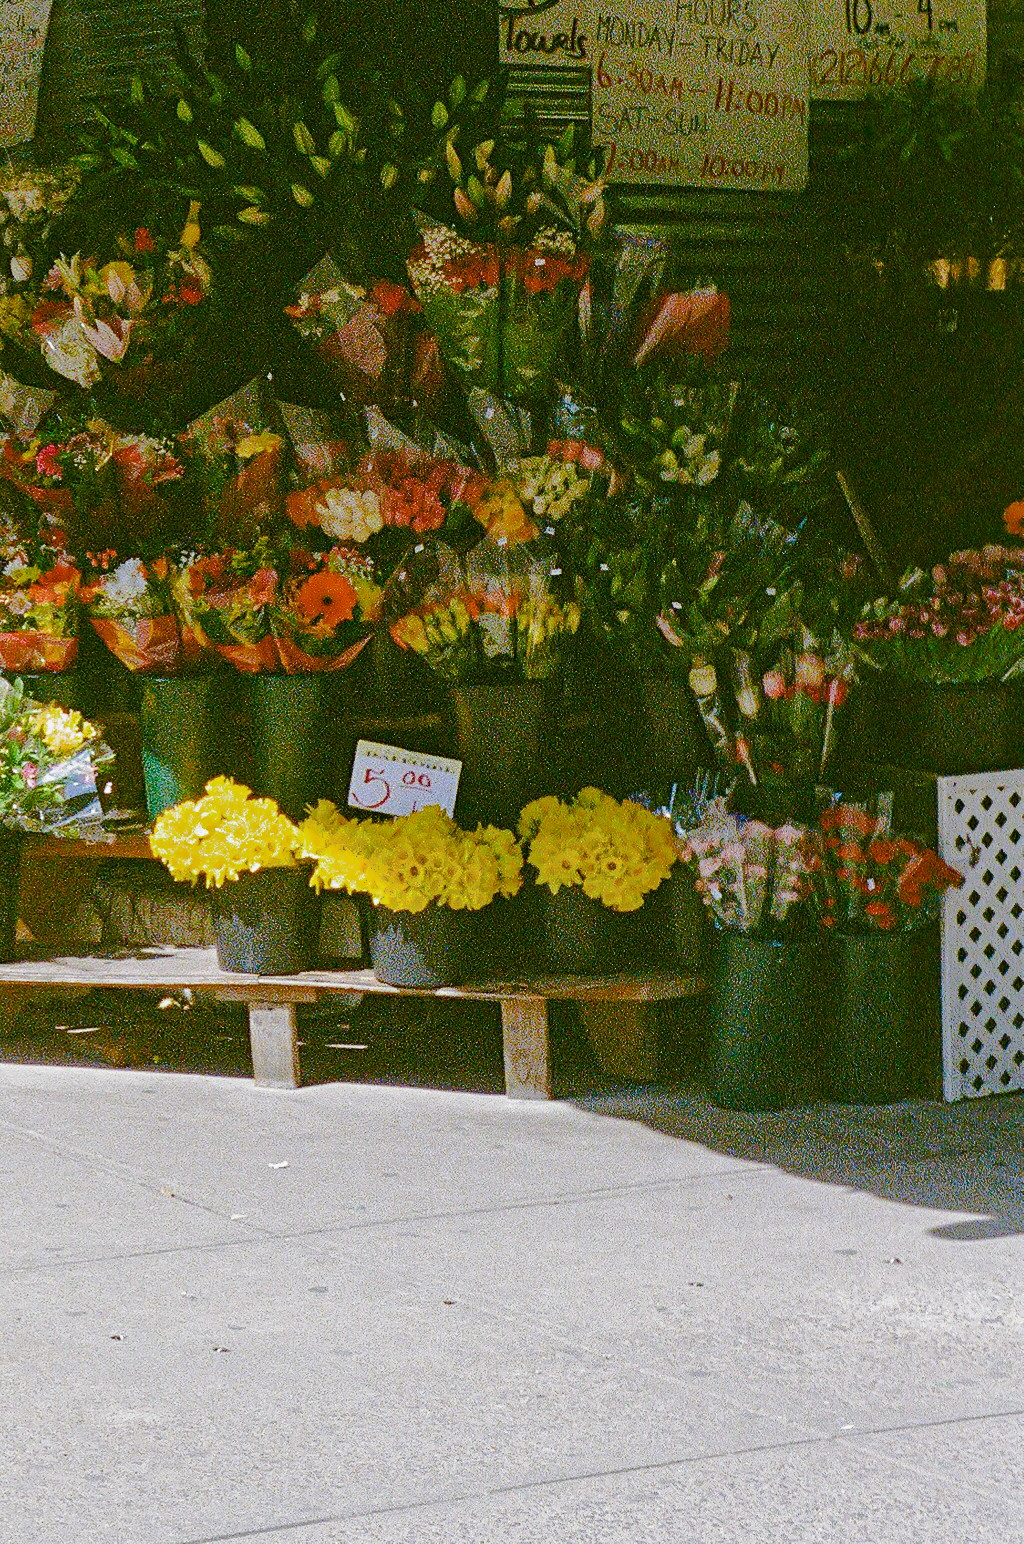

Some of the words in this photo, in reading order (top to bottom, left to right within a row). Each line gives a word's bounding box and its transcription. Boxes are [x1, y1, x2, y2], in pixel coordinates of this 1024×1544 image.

[499, 15, 588, 60] Towels
[595, 14, 676, 57] MONDAY
[700, 33, 780, 69] FRIDAY
